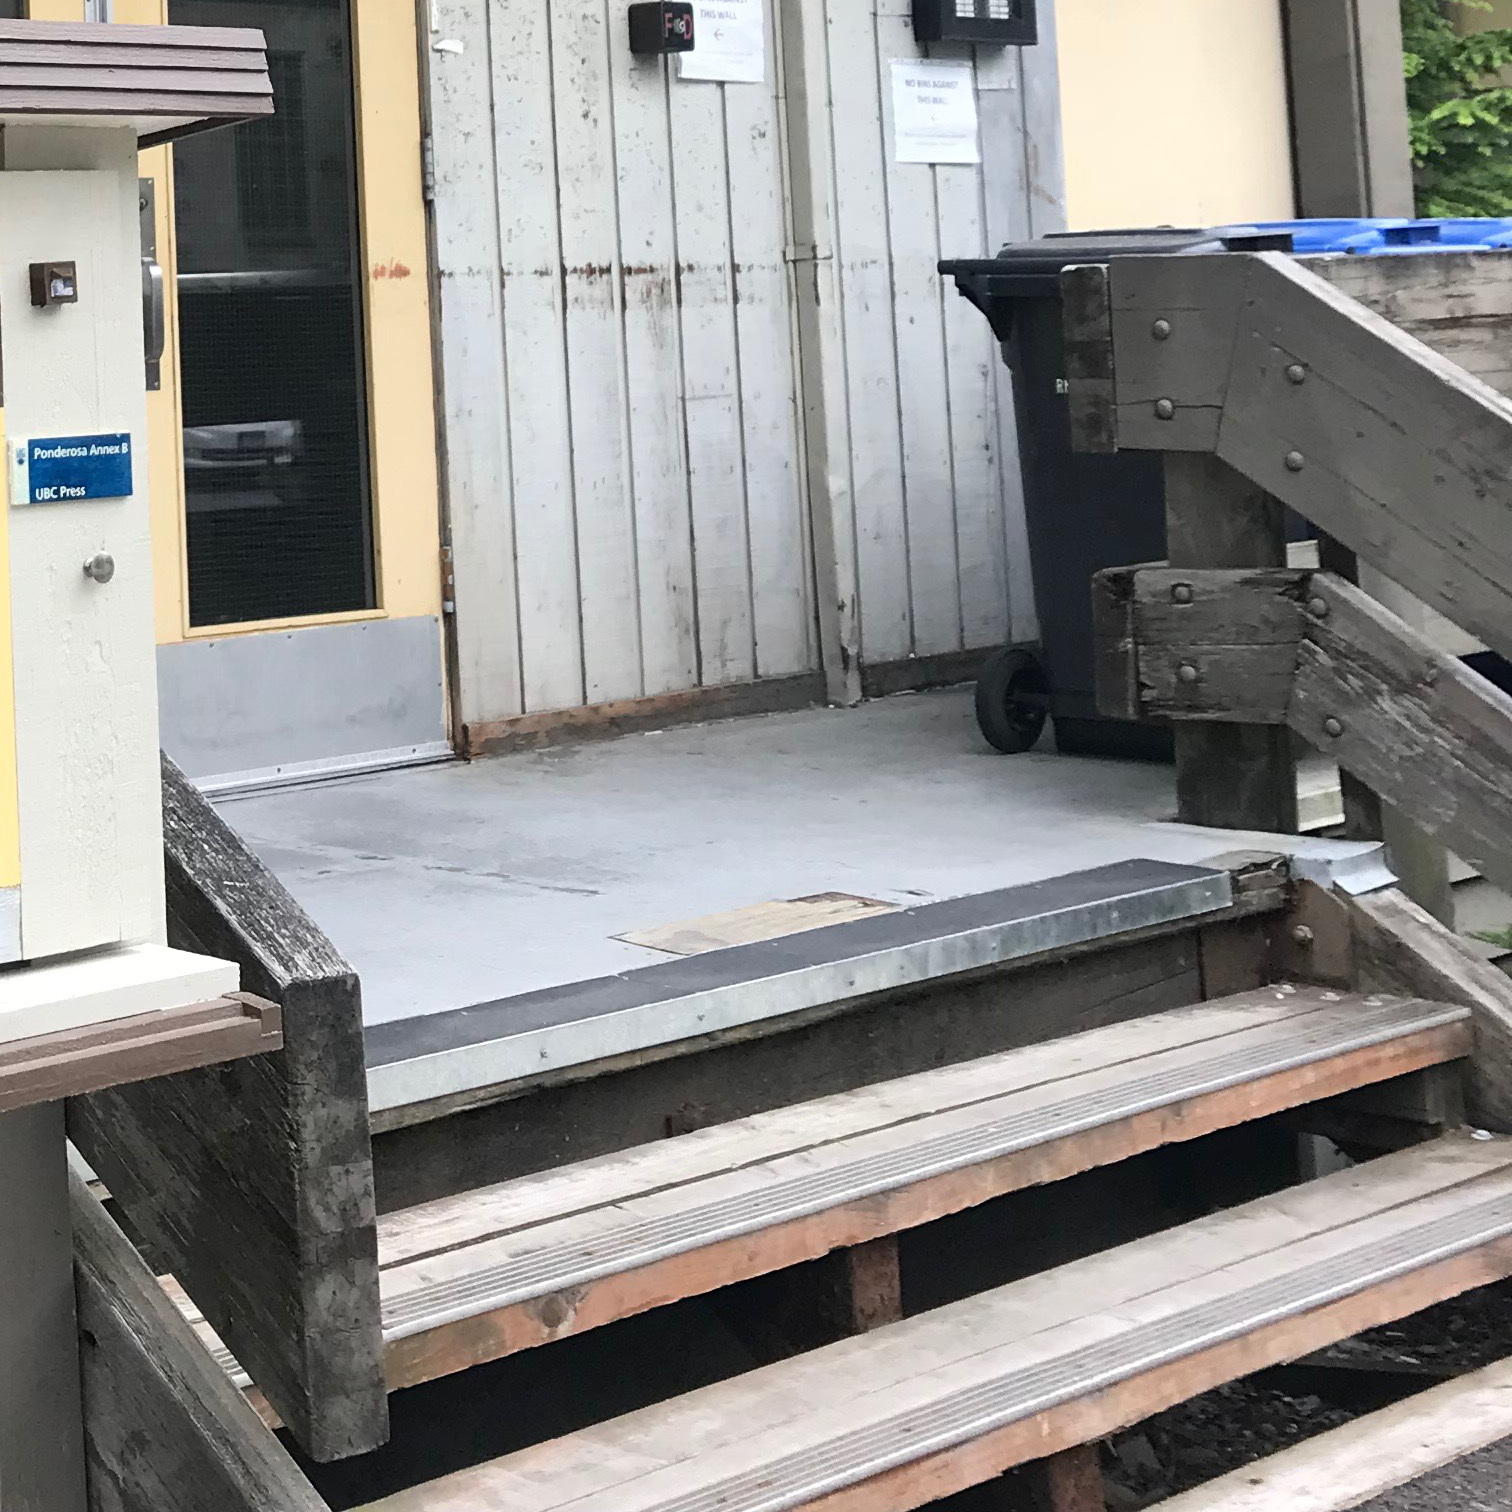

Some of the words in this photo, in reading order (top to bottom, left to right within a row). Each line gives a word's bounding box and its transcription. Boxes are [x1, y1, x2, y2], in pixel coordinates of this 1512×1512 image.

[700, 9, 716, 19] THIS
[717, 10, 737, 20] WALL
[34, 446, 87, 460] Ponderosa
[89, 444, 120, 456] Annex
[122, 442, 129, 454] B
[35, 487, 58, 500] UBC
[59, 486, 86, 498] Press
